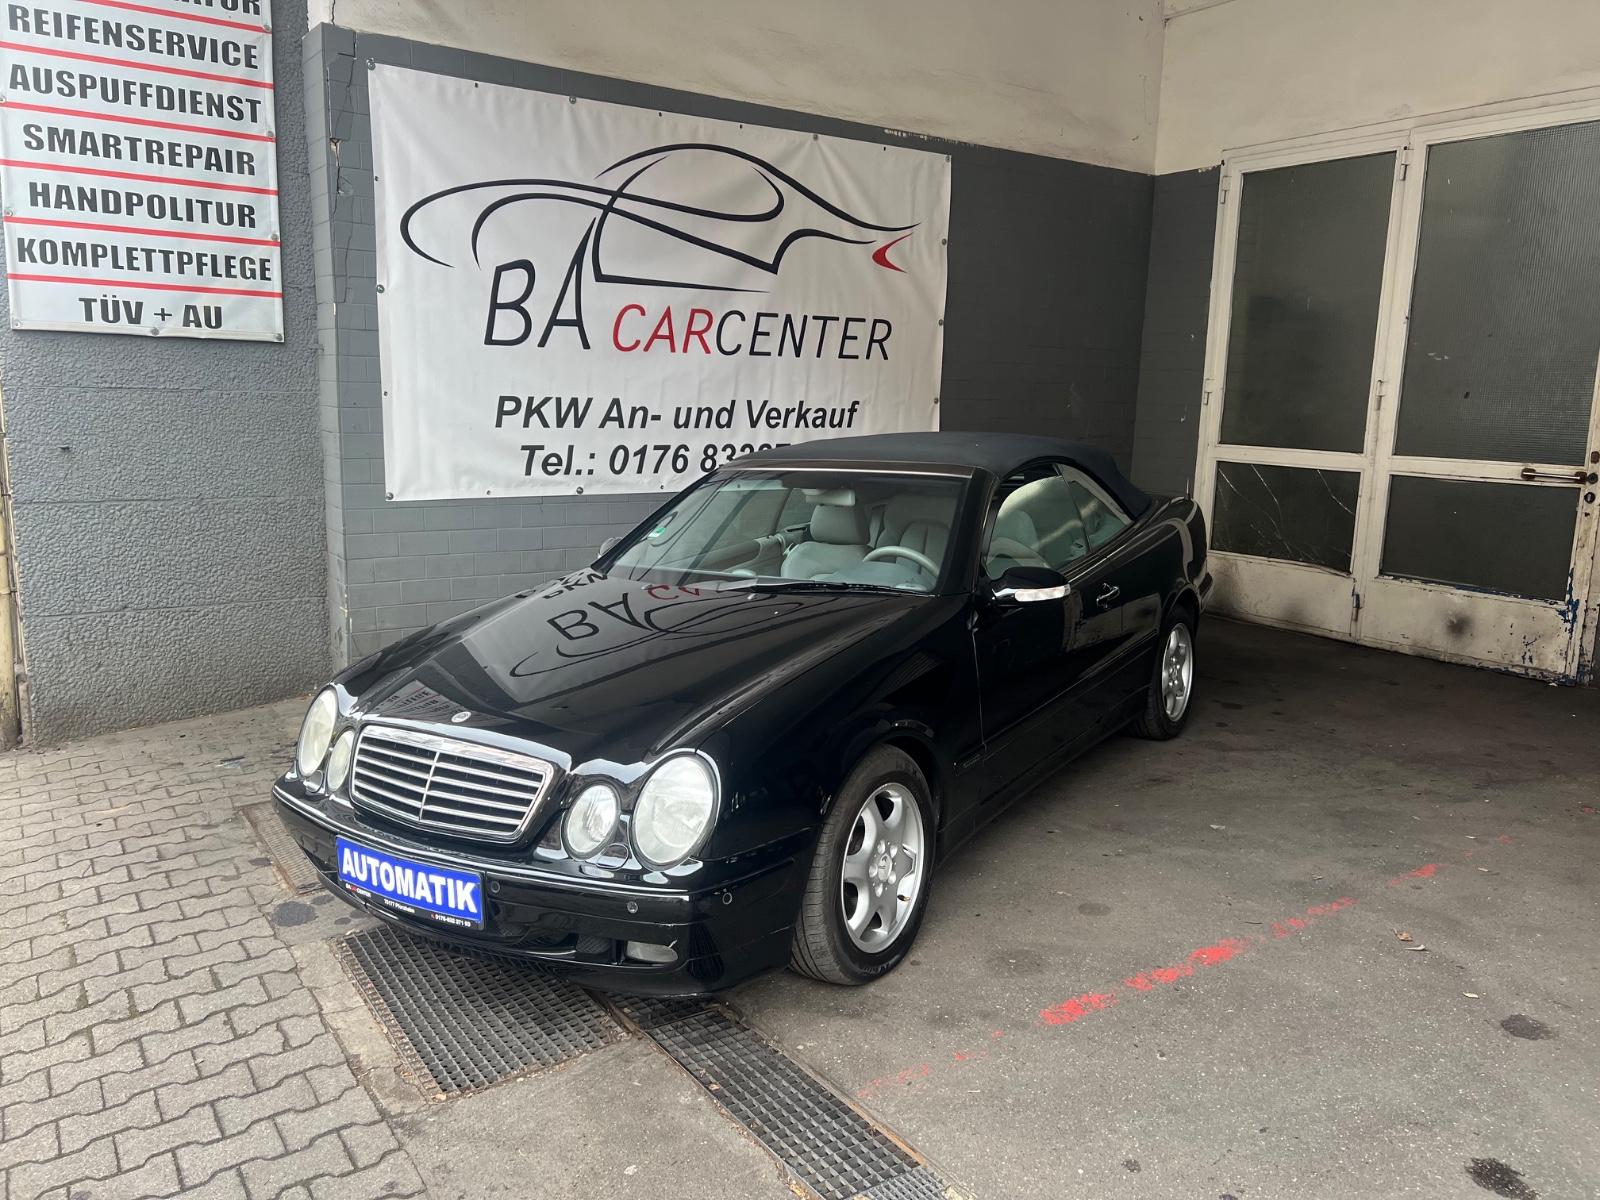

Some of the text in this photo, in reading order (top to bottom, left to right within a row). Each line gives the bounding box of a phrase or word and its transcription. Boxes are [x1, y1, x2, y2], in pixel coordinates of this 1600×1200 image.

[9, 4, 259, 70] REIFENSERVICE
[9, 64, 262, 124] AUSPUFFDIENST
[23, 123, 256, 176] SMARTREPAIR
[29, 181, 256, 229] HANDPOLITUR
[17, 237, 272, 281] KOMPLETTPFLEGE
[78, 294, 223, 329] TÜV + AU
[484, 219, 892, 361] BA CARCENTER
[495, 395, 861, 429] PKW An- und Verkauf
[519, 444, 596, 476] Tel.:
[609, 444, 690, 475] 0176
[342, 847, 478, 913] AUTOMATIK
